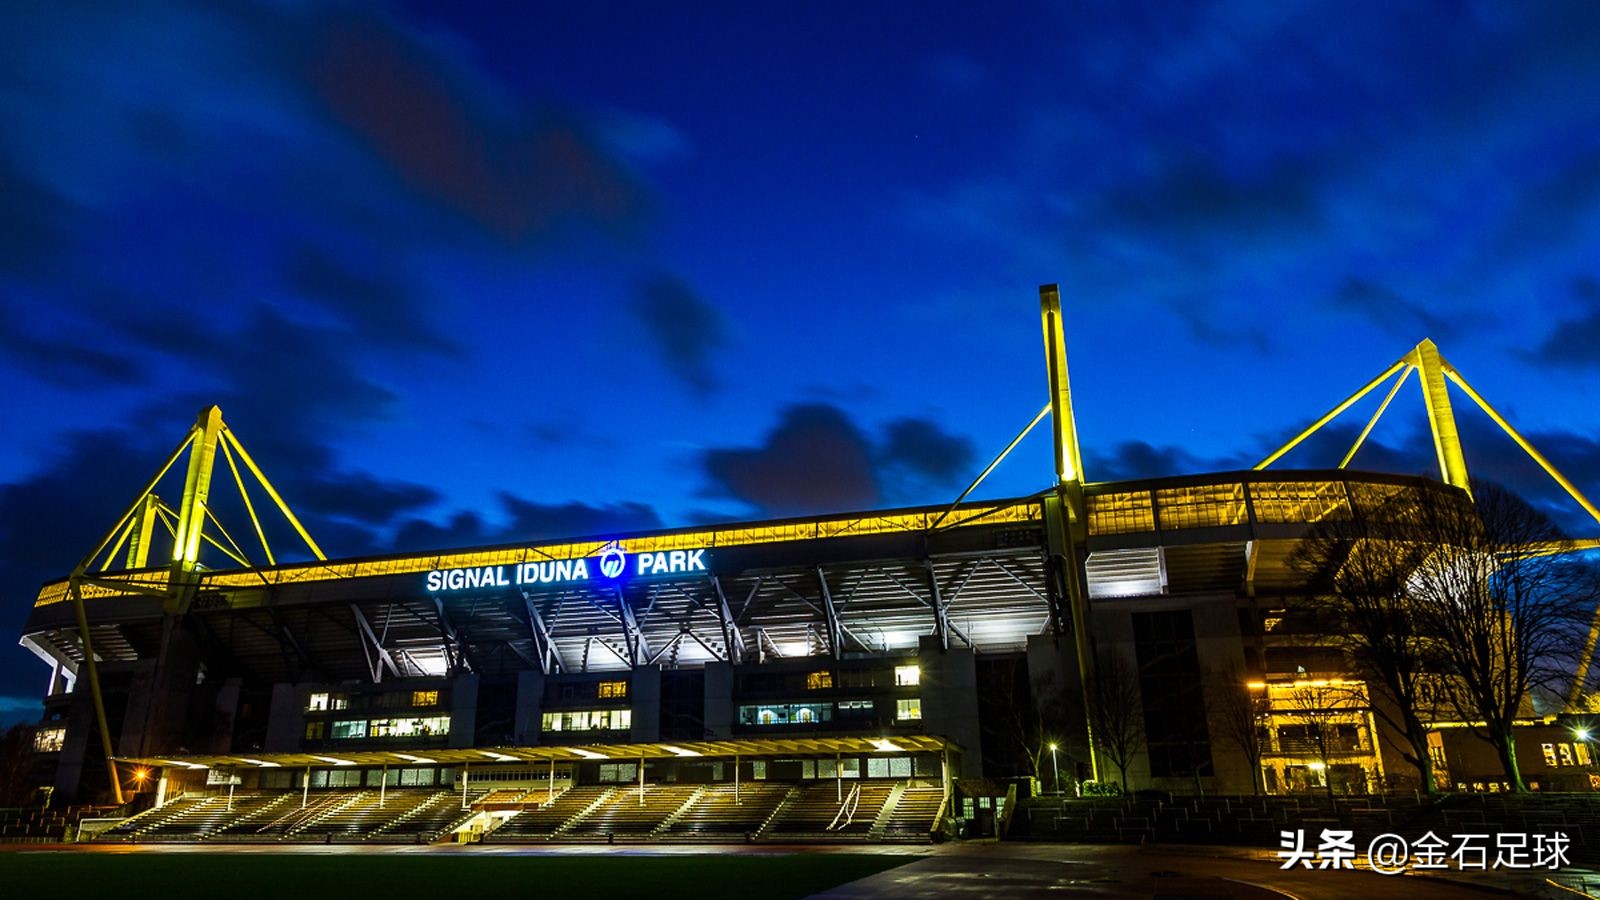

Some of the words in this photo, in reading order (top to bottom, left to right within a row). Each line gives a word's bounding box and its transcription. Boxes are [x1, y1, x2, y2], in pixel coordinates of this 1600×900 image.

[427, 566, 510, 591] SIGNAL
[516, 556, 589, 585] IDUNA
[638, 549, 706, 576] PARK
